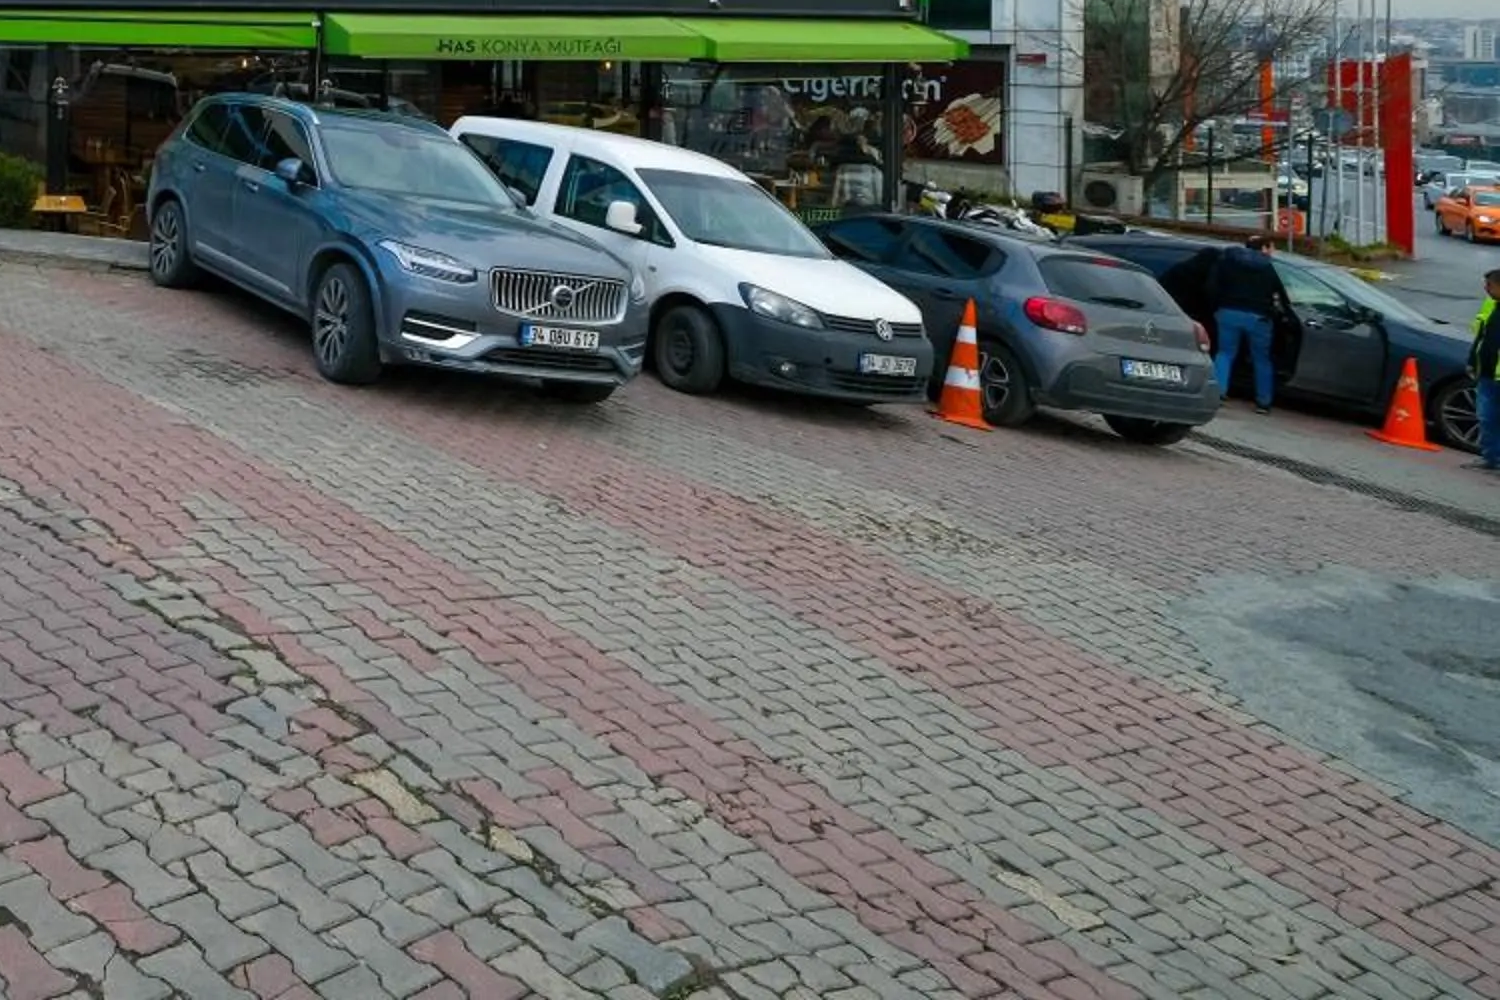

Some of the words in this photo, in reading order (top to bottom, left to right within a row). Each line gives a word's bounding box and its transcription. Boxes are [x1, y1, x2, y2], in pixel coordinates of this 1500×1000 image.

[437, 38, 475, 53] HAS
[481, 38, 541, 54] KONYA
[548, 36, 622, 54] MUTFAĞI
